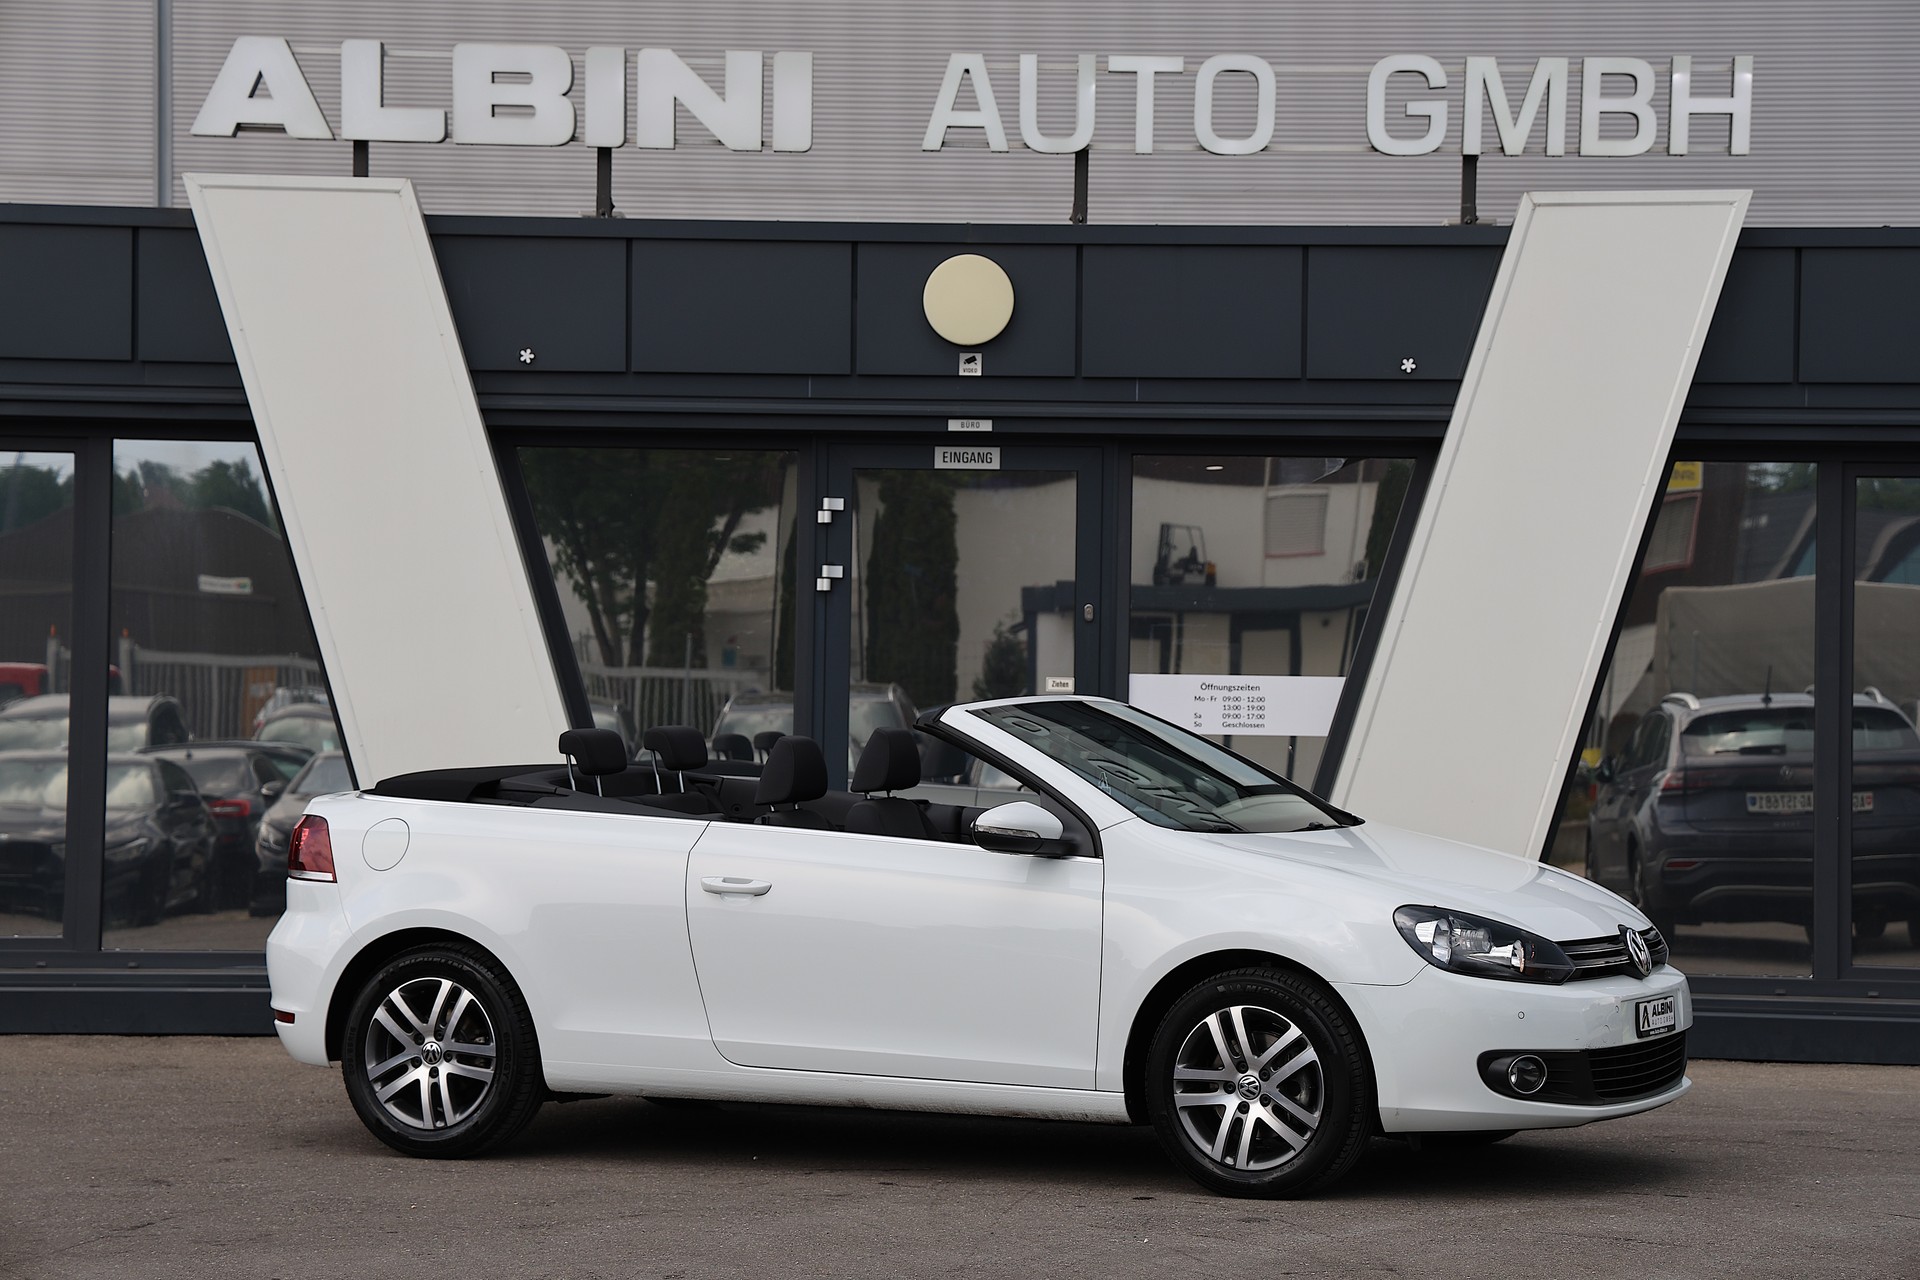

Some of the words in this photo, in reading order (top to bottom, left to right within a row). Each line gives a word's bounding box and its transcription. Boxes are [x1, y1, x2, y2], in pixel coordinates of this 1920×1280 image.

[189, 35, 814, 154] ALBINI
[921, 53, 1277, 156] AUTO
[1365, 53, 1754, 157] GMBH
[960, 421, 981, 429] BÜRO
[942, 451, 993, 464] EINGANG
[1051, 680, 1070, 688] Ziehen
[1200, 682, 1261, 692] Öffnungszeiten
[1222, 695, 1242, 703] 09:00
[1247, 704, 1266, 712] 19:00
[1222, 712, 1242, 720] 09:00
[1193, 720, 1203, 728] So
[1222, 721, 1266, 729] Geschlossen
[1652, 1000, 1673, 1018] ALBINI
